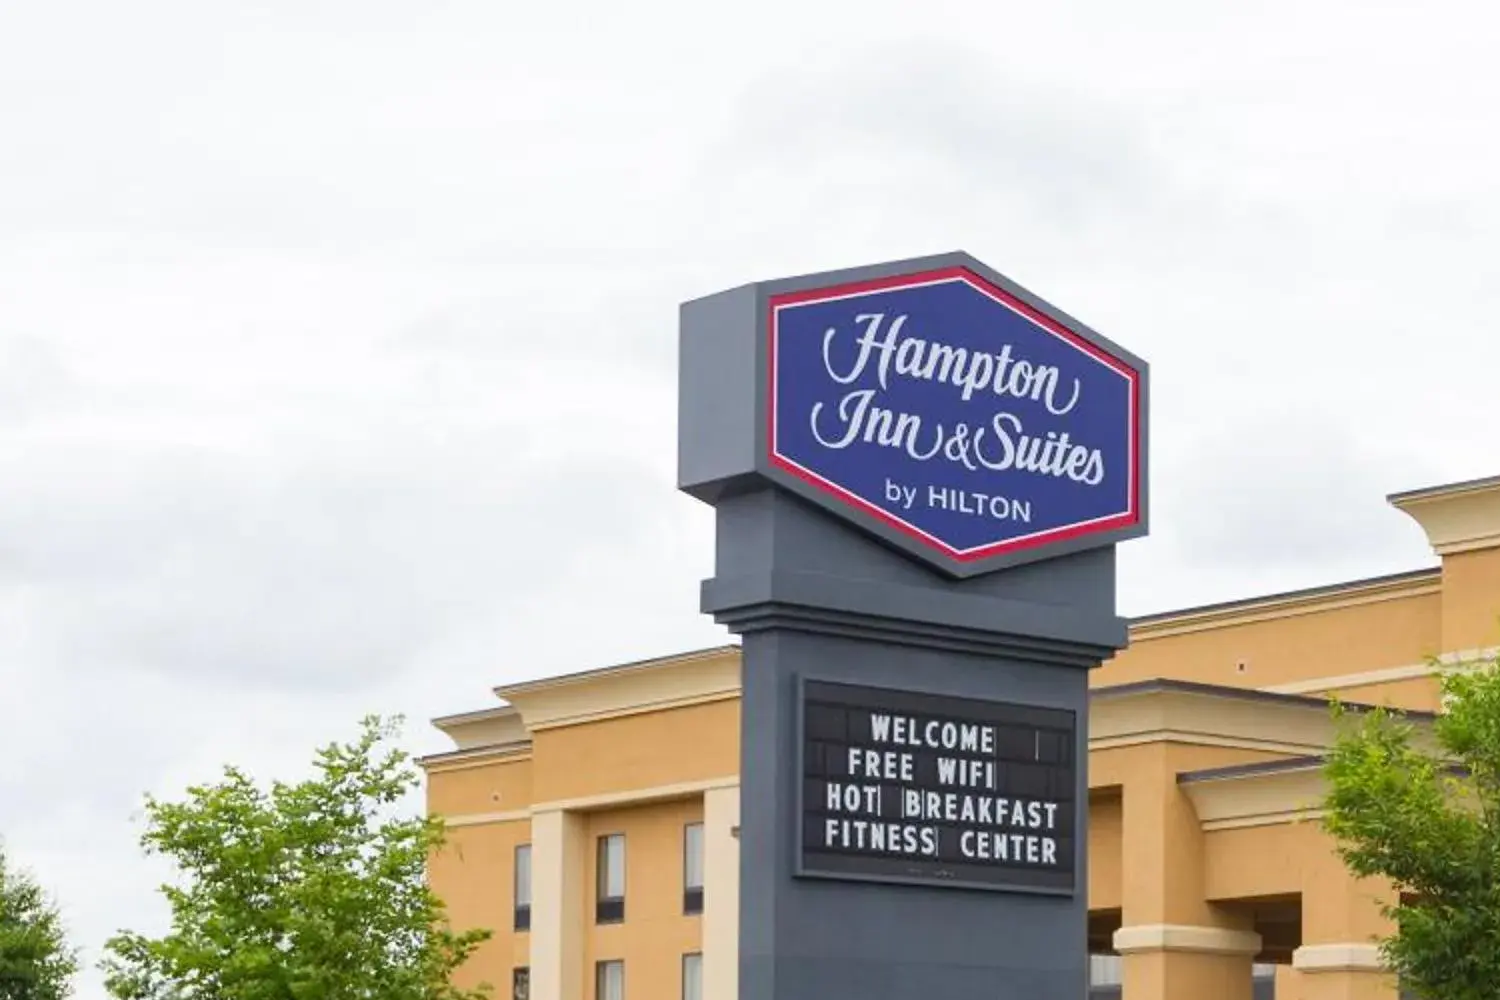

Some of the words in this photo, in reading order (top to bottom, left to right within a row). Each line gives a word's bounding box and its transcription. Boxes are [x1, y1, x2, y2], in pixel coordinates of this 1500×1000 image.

[823, 313, 1080, 415] Hampton
[810, 389, 943, 460] Inn
[944, 423, 976, 471] &
[975, 412, 1104, 486] Suites
[885, 479, 917, 509] by
[928, 486, 1032, 523] HILTON
[870, 713, 993, 753] WELCOME
[848, 747, 913, 781] FREE
[937, 757, 993, 788] WIFI
[827, 783, 876, 813] HOT
[905, 789, 1058, 829] BREAKFAST
[825, 819, 935, 855] FITNESS
[960, 830, 1057, 864] CENTER
